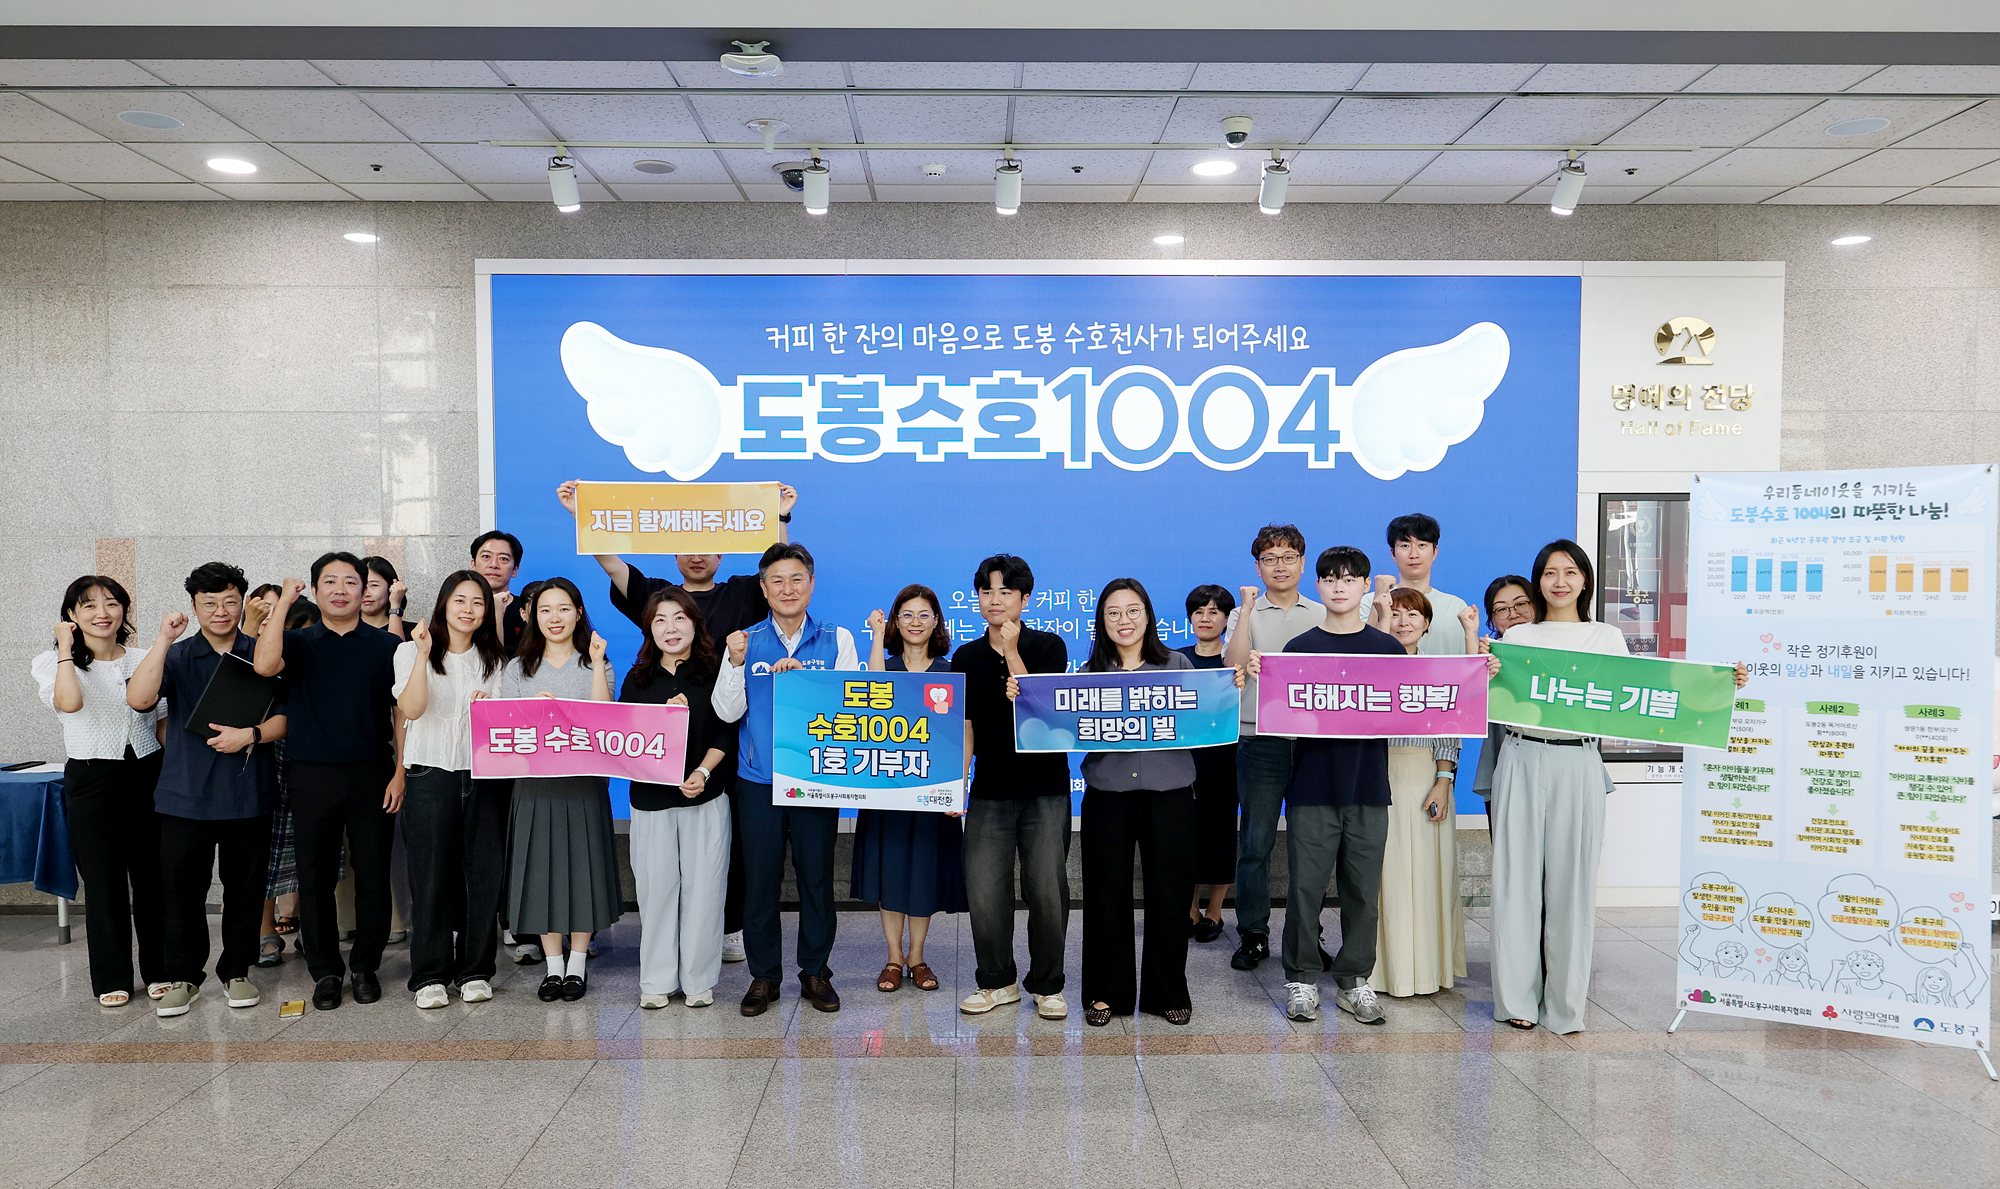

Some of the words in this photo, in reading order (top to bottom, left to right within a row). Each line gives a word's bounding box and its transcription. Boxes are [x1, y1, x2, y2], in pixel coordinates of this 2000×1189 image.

[765, 323, 815, 353] 커피
[821, 321, 848, 355] 한
[854, 322, 903, 355] 잔의
[912, 321, 1005, 355] 마음으로
[1012, 322, 1056, 355] 도봉
[1064, 321, 1185, 355] 수호천사가
[1192, 323, 1311, 354] 되어주세요
[1612, 384, 1692, 411] 명예의
[1700, 384, 1755, 411] 전당
[738, 370, 1342, 466] 도봉수호1004
[1621, 420, 1658, 435] Hall
[1665, 420, 1684, 435] of
[1690, 420, 1743, 435] Fame
[1763, 481, 1864, 500] 우리동네이웃을
[1872, 482, 1917, 497] 지키는
[1730, 506, 1789, 523] 도봉수호
[1793, 505, 1846, 520] 1004의
[1853, 503, 1905, 521] 따뜻한
[1909, 502, 1949, 520] 나눔!
[590, 509, 633, 532] 지금
[638, 508, 766, 532] 함께해주세요
[1036, 589, 1071, 612] 커피
[1076, 589, 1097, 613] 한
[1786, 644, 1812, 658] 작은
[1816, 644, 1878, 660] 정기후원이
[1746, 662, 1781, 677] 이웃의
[1785, 663, 1823, 678] 일상과
[1827, 664, 1866, 679] 내일을
[1870, 665, 1908, 680] 지키고
[1912, 666, 1970, 681] 있습니다!
[843, 680, 894, 710] 도봉
[1054, 687, 1123, 712] 미래를
[1128, 685, 1198, 711] 밝히는
[1287, 682, 1392, 712] 더해지는
[1398, 683, 1459, 713] 행복!
[1529, 675, 1614, 712] 나누는
[1619, 685, 1680, 719] 기쁨
[1735, 701, 1749, 710] 례1
[1819, 704, 1844, 713] 사례2
[1918, 708, 1945, 717] 사례3
[808, 712, 930, 744] 수호1004
[1078, 717, 1147, 742] 희망의
[1152, 715, 1176, 742] 빛
[489, 726, 538, 754] 도봉
[809, 746, 848, 775] 1호
[853, 748, 930, 779] 기부자
[1722, 765, 1750, 773] 아이들을
[1753, 767, 1774, 775] 키우며
[1720, 773, 1756, 782] 생활하는데
[1811, 778, 1834, 786] 건강도
[1836, 779, 1850, 787] 많이
[1708, 781, 1715, 789] 큰
[1717, 782, 1731, 790] 힘이
[1937, 785, 1953, 793] 있어
[917, 795, 953, 806] 도봉대전환
[1897, 791, 1905, 799] 큰
[1907, 792, 1922, 800] 힘이
[1702, 883, 1734, 892] 도봉구에서
[1692, 892, 1711, 900] 발생한
[1730, 896, 1743, 904] 피해
[1838, 895, 1858, 903] 생활이
[1861, 897, 1881, 905] 어려운
[1701, 903, 1720, 911] 주민을
[1723, 905, 1735, 913] 위한
[1843, 905, 1878, 915] 도봉구민의
[1702, 913, 1734, 923] 긴급구호비
[1753, 915, 1772, 923] 도봉을
[1775, 917, 1795, 926] 만들기
[1797, 920, 1811, 928] 위한
[1876, 919, 1889, 927] 지원
[1914, 917, 1943, 926] 도봉구의
[1789, 929, 1802, 937] 지원
[1919, 939, 1940, 948] 어르신
[1942, 941, 1957, 950] 지원
[1720, 998, 1811, 1016] 서울특별시도봉구사회복지협의회
[1841, 1008, 1899, 1023] 사랑의열매
[1940, 1022, 1979, 1037] 도봉구
